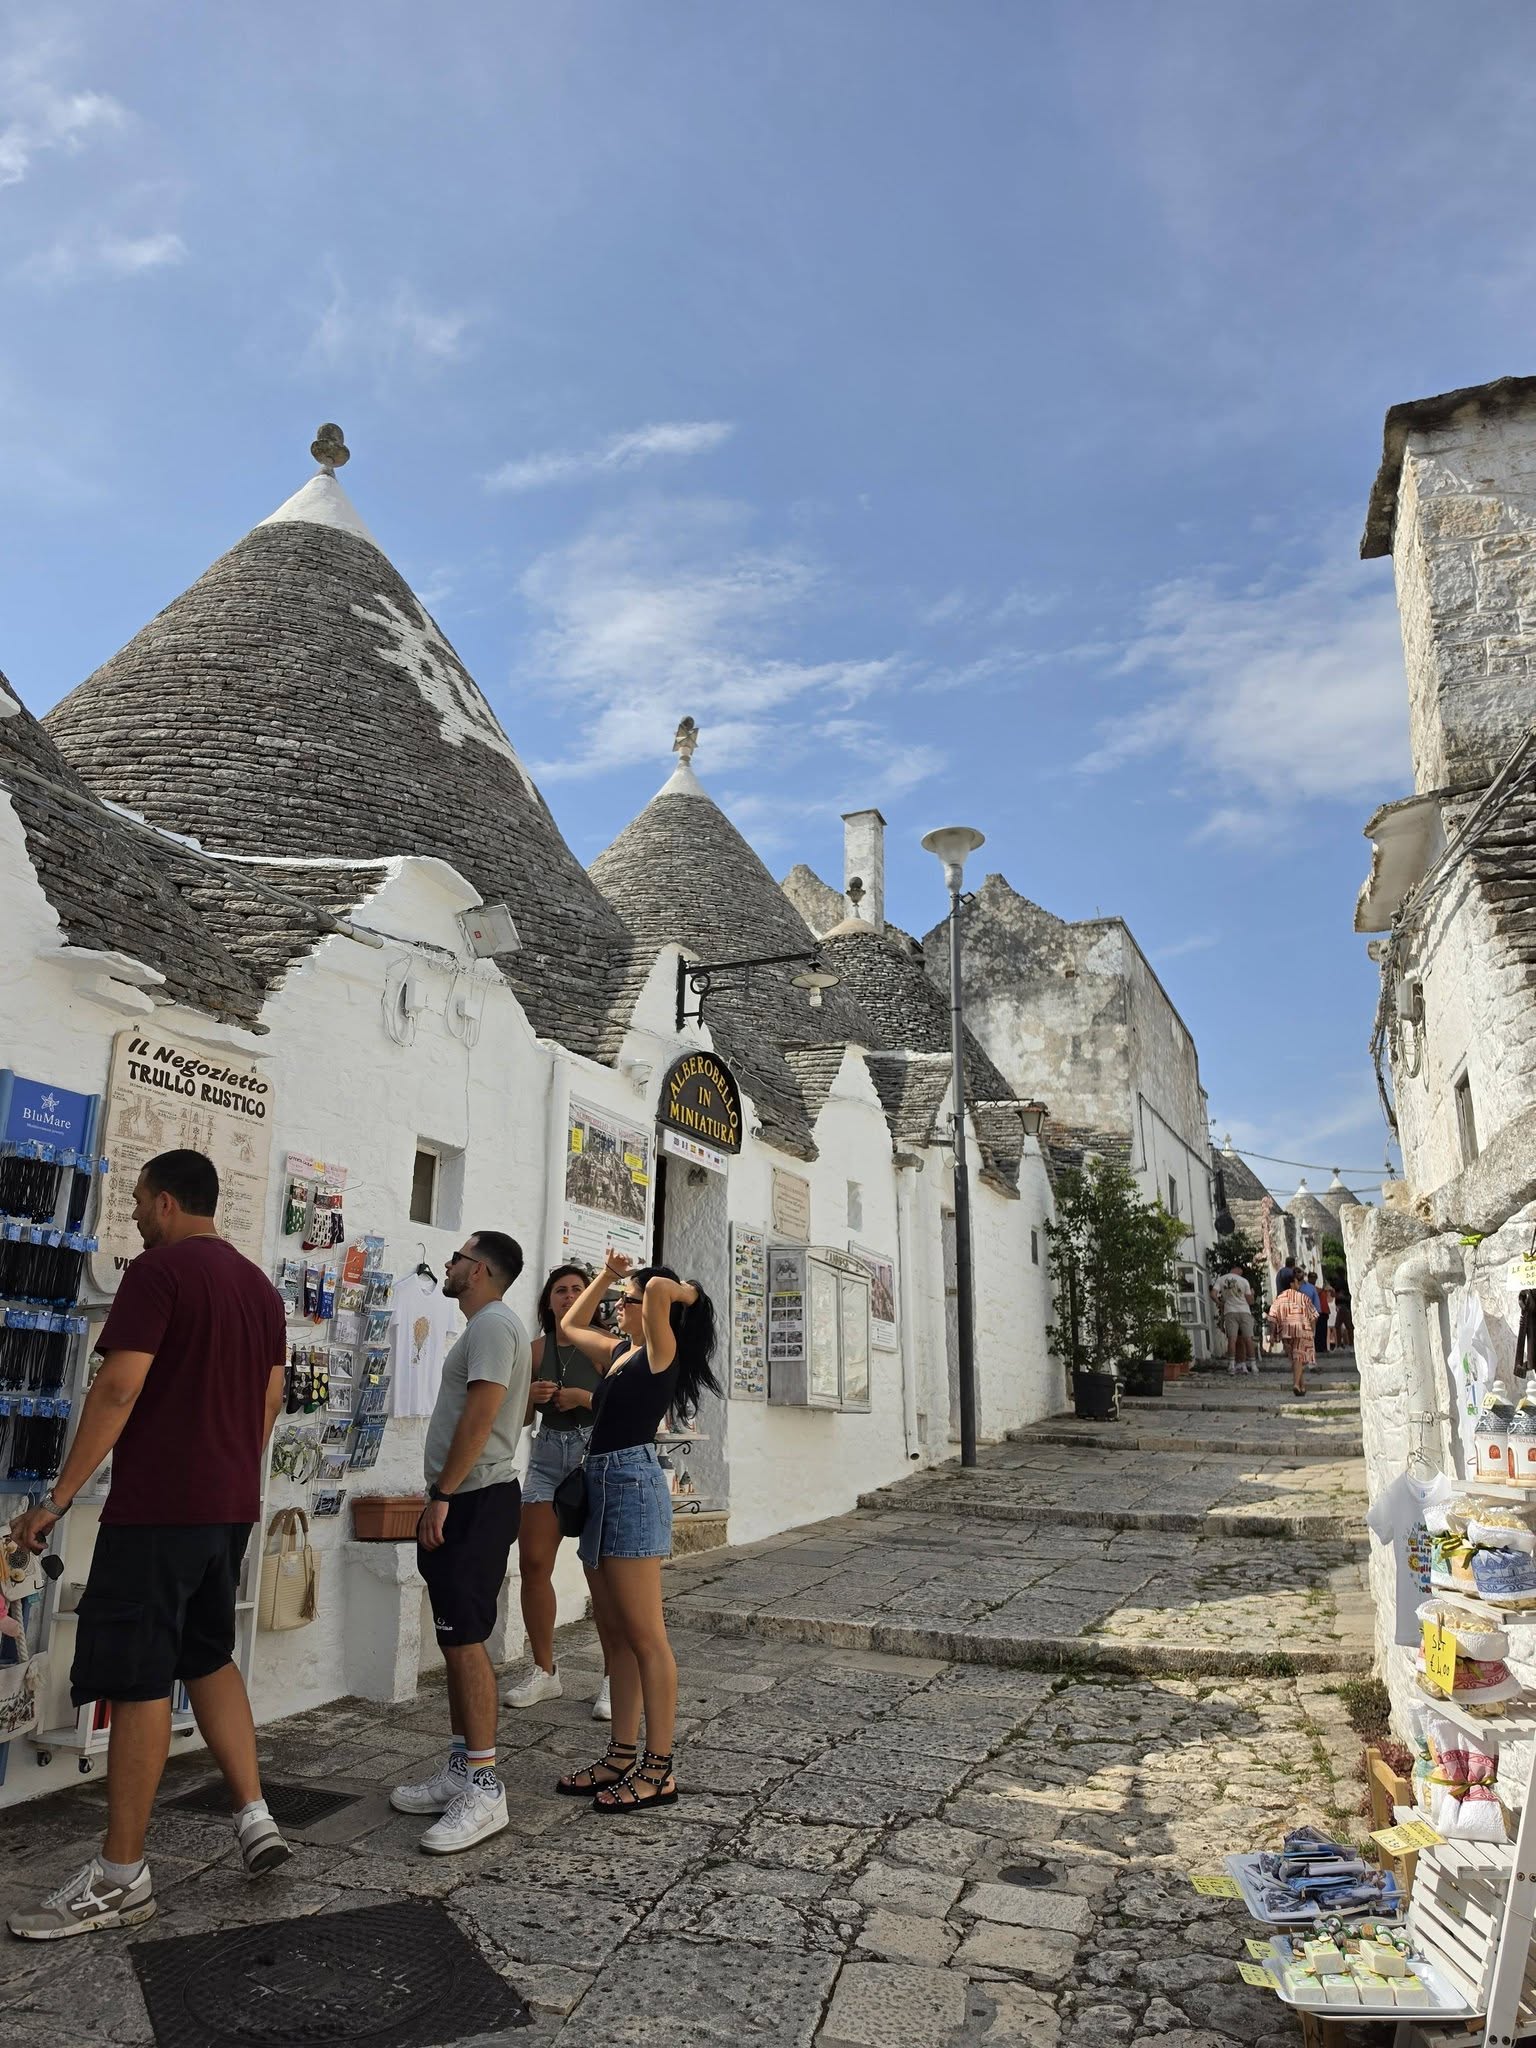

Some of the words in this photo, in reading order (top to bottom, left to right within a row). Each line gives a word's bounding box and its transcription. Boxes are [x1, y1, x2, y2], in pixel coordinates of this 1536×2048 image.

[127, 1060, 196, 1097] TRULLO
[200, 1083, 266, 1119] RUSTICO
[153, 1046, 268, 1094] Negozietto
[669, 1056, 739, 1129] ALBEROBELLO
[22, 1107, 72, 1129] BluMare
[698, 1086, 712, 1107] IN
[669, 1100, 735, 1146] MINIATURA
